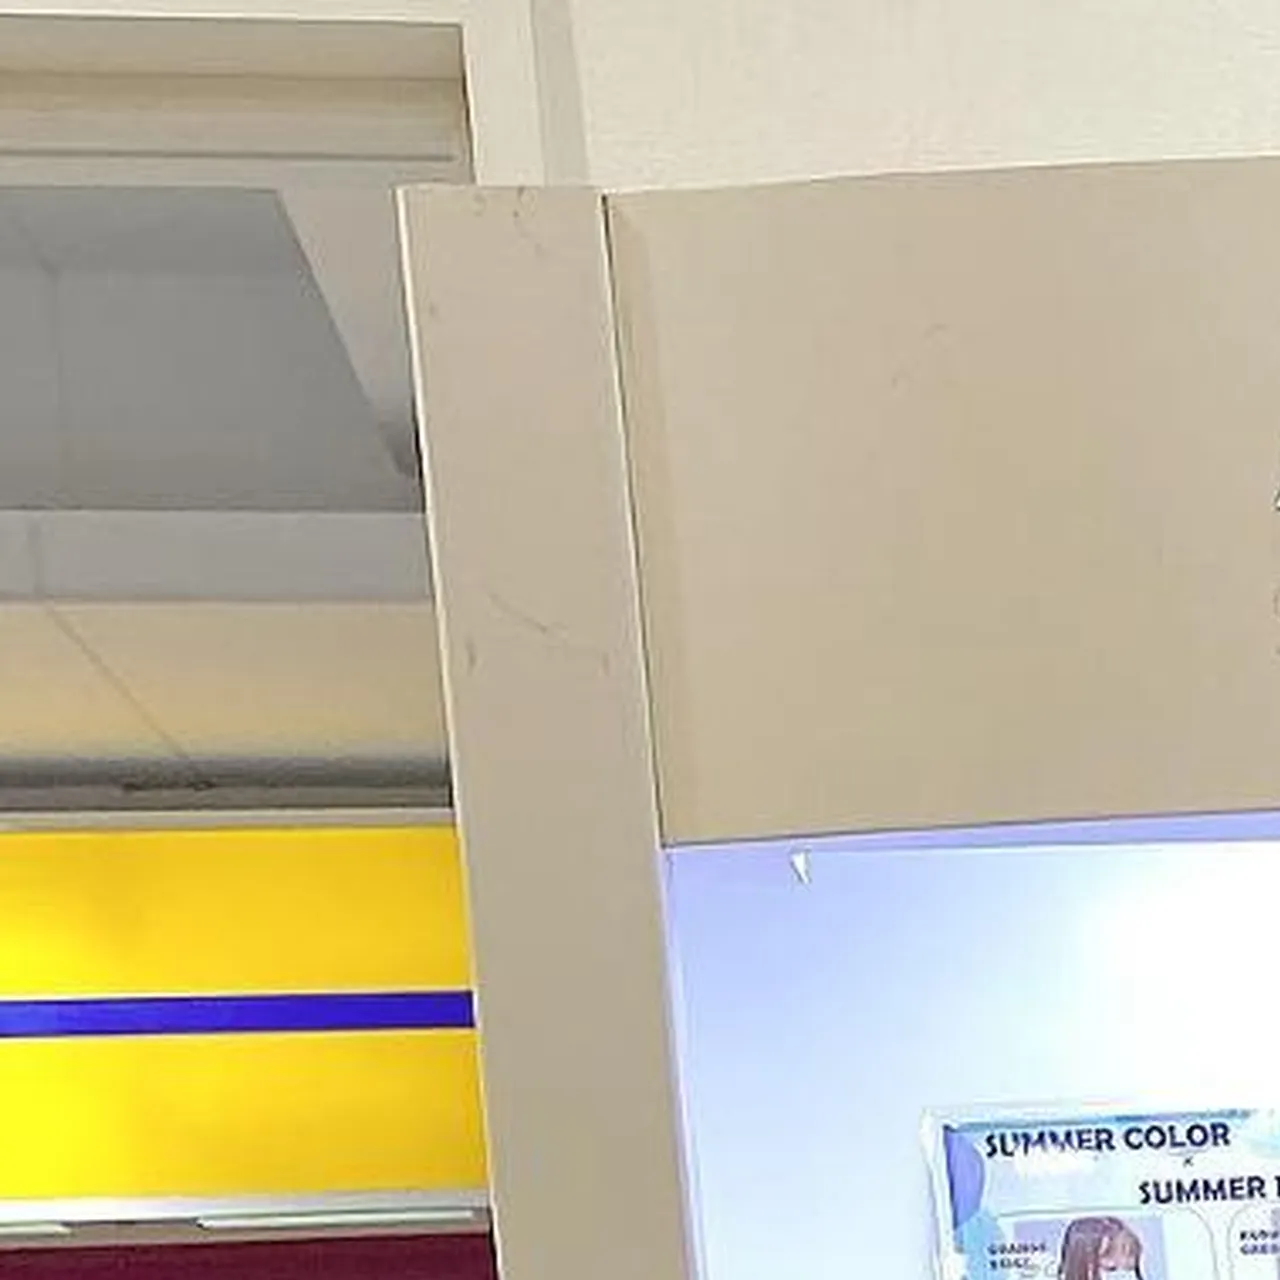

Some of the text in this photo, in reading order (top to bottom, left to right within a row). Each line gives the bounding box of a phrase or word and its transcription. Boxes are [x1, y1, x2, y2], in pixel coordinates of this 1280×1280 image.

[984, 1122, 1232, 1158] SUMMER COLOR
[1138, 1174, 1267, 1204] SUMMER
